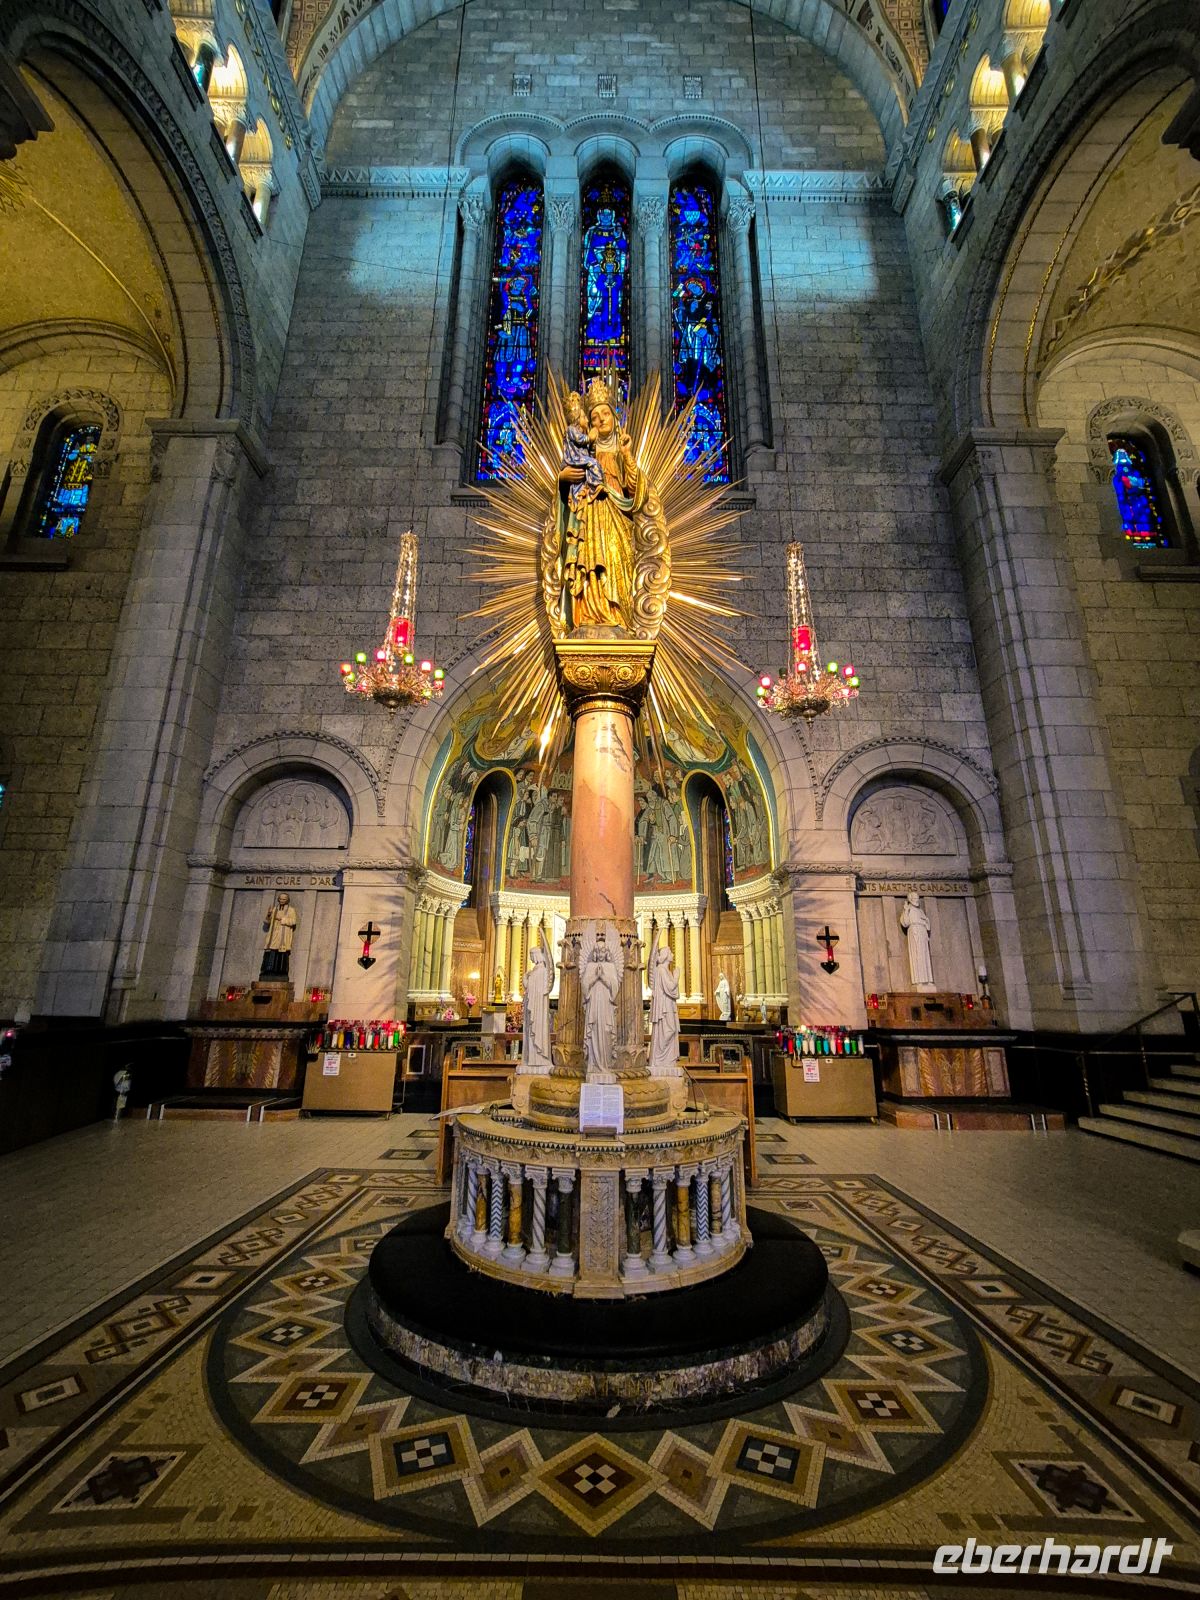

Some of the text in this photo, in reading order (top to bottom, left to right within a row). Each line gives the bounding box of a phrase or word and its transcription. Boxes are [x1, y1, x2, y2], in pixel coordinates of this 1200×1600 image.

[245, 875, 270, 886] SAINT
[310, 875, 337, 886] D'ARS
[878, 882, 917, 892] MARTYRS
[919, 883, 968, 893] CANADIENS
